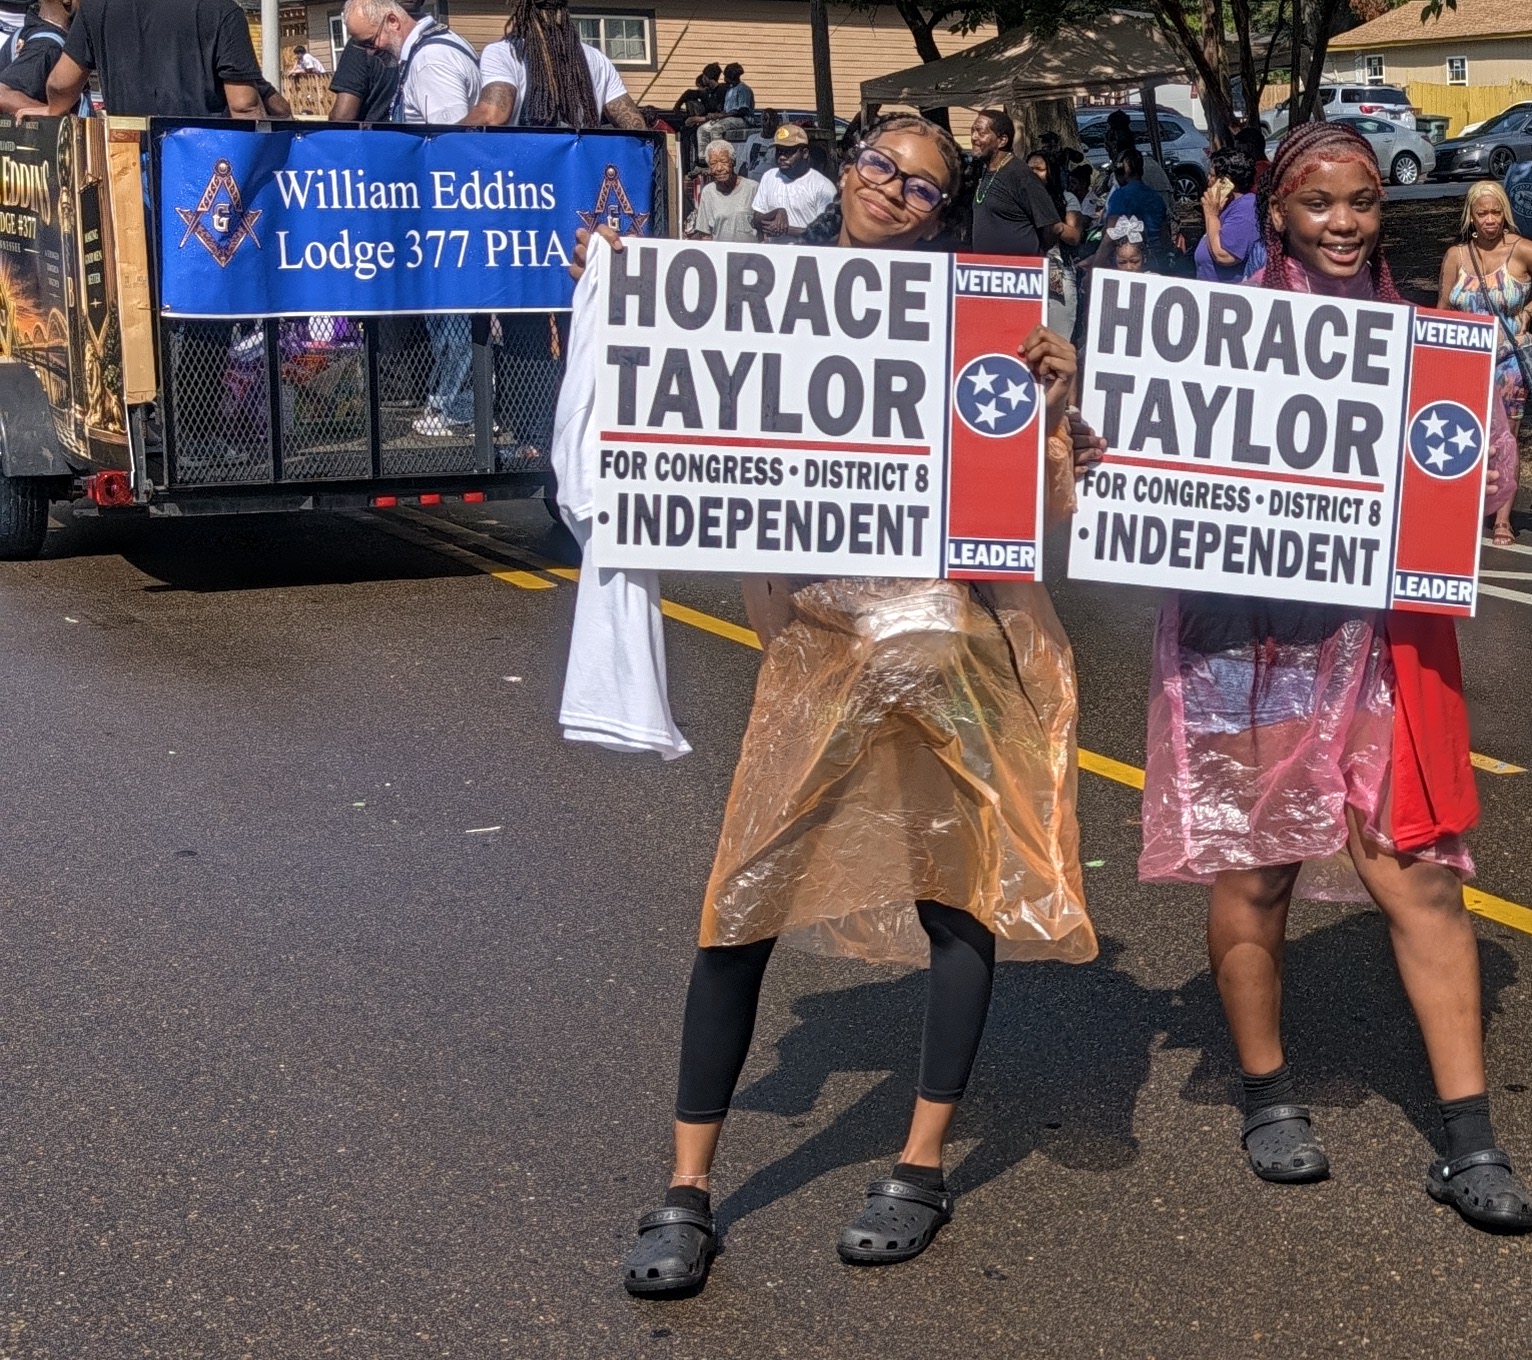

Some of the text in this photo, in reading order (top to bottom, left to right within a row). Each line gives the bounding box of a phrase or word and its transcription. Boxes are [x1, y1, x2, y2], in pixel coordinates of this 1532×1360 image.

[2, 156, 50, 225] EDDINS
[273, 169, 556, 210] William Eddins
[0, 211, 37, 239] DGE #377
[276, 229, 573, 280] Lodge 377 PHA
[607, 247, 932, 342] HORACE
[956, 268, 1043, 296] VETERAN
[1097, 278, 1394, 386] HORACE
[1414, 320, 1494, 349] VETERAN
[606, 344, 927, 439] TAYLOR
[1095, 370, 1384, 477] TAYLOR
[600, 449, 930, 493] FOR CONGRESS DISTRICT 8
[616, 492, 931, 557] INDEPENDENT
[1083, 470, 1382, 526] FOR CONGRESS DISTRICT 8
[949, 543, 1036, 567] LEADER
[1094, 511, 1381, 586] INDEPENDENT
[1394, 576, 1473, 602] LEADER
